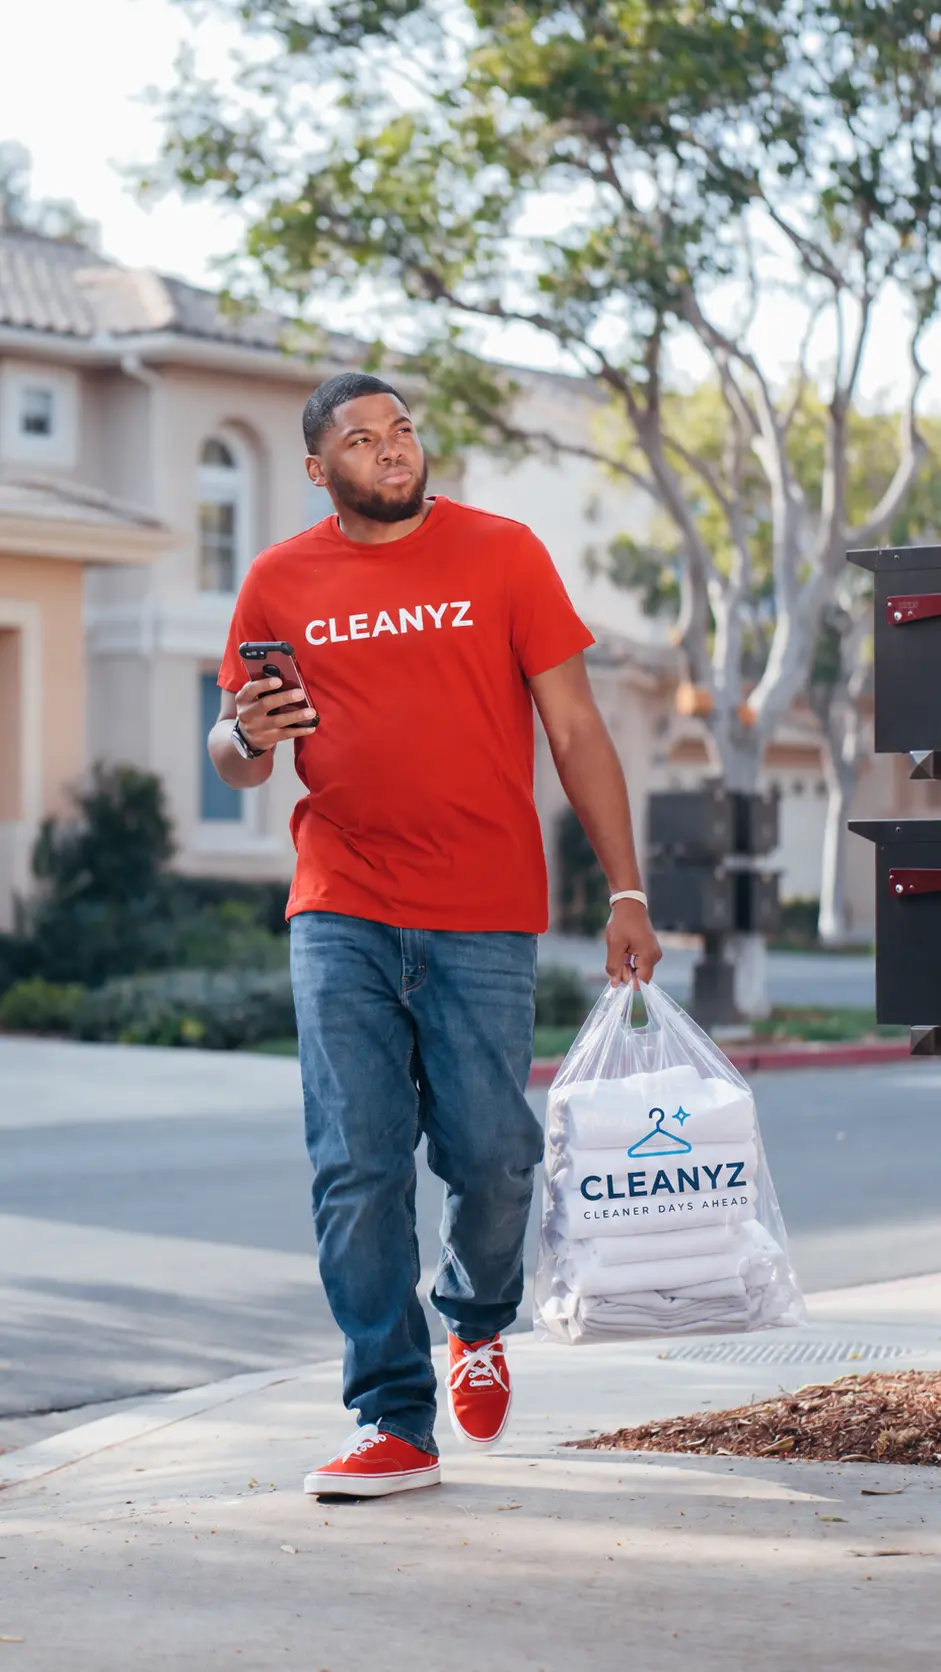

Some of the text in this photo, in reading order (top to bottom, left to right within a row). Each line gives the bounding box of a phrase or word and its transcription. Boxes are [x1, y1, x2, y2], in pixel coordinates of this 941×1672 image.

[305, 600, 474, 646] CLEANYZ
[580, 1161, 747, 1201] CLEANYZ
[583, 1196, 749, 1220] CLEANER DAYS AHEAD
